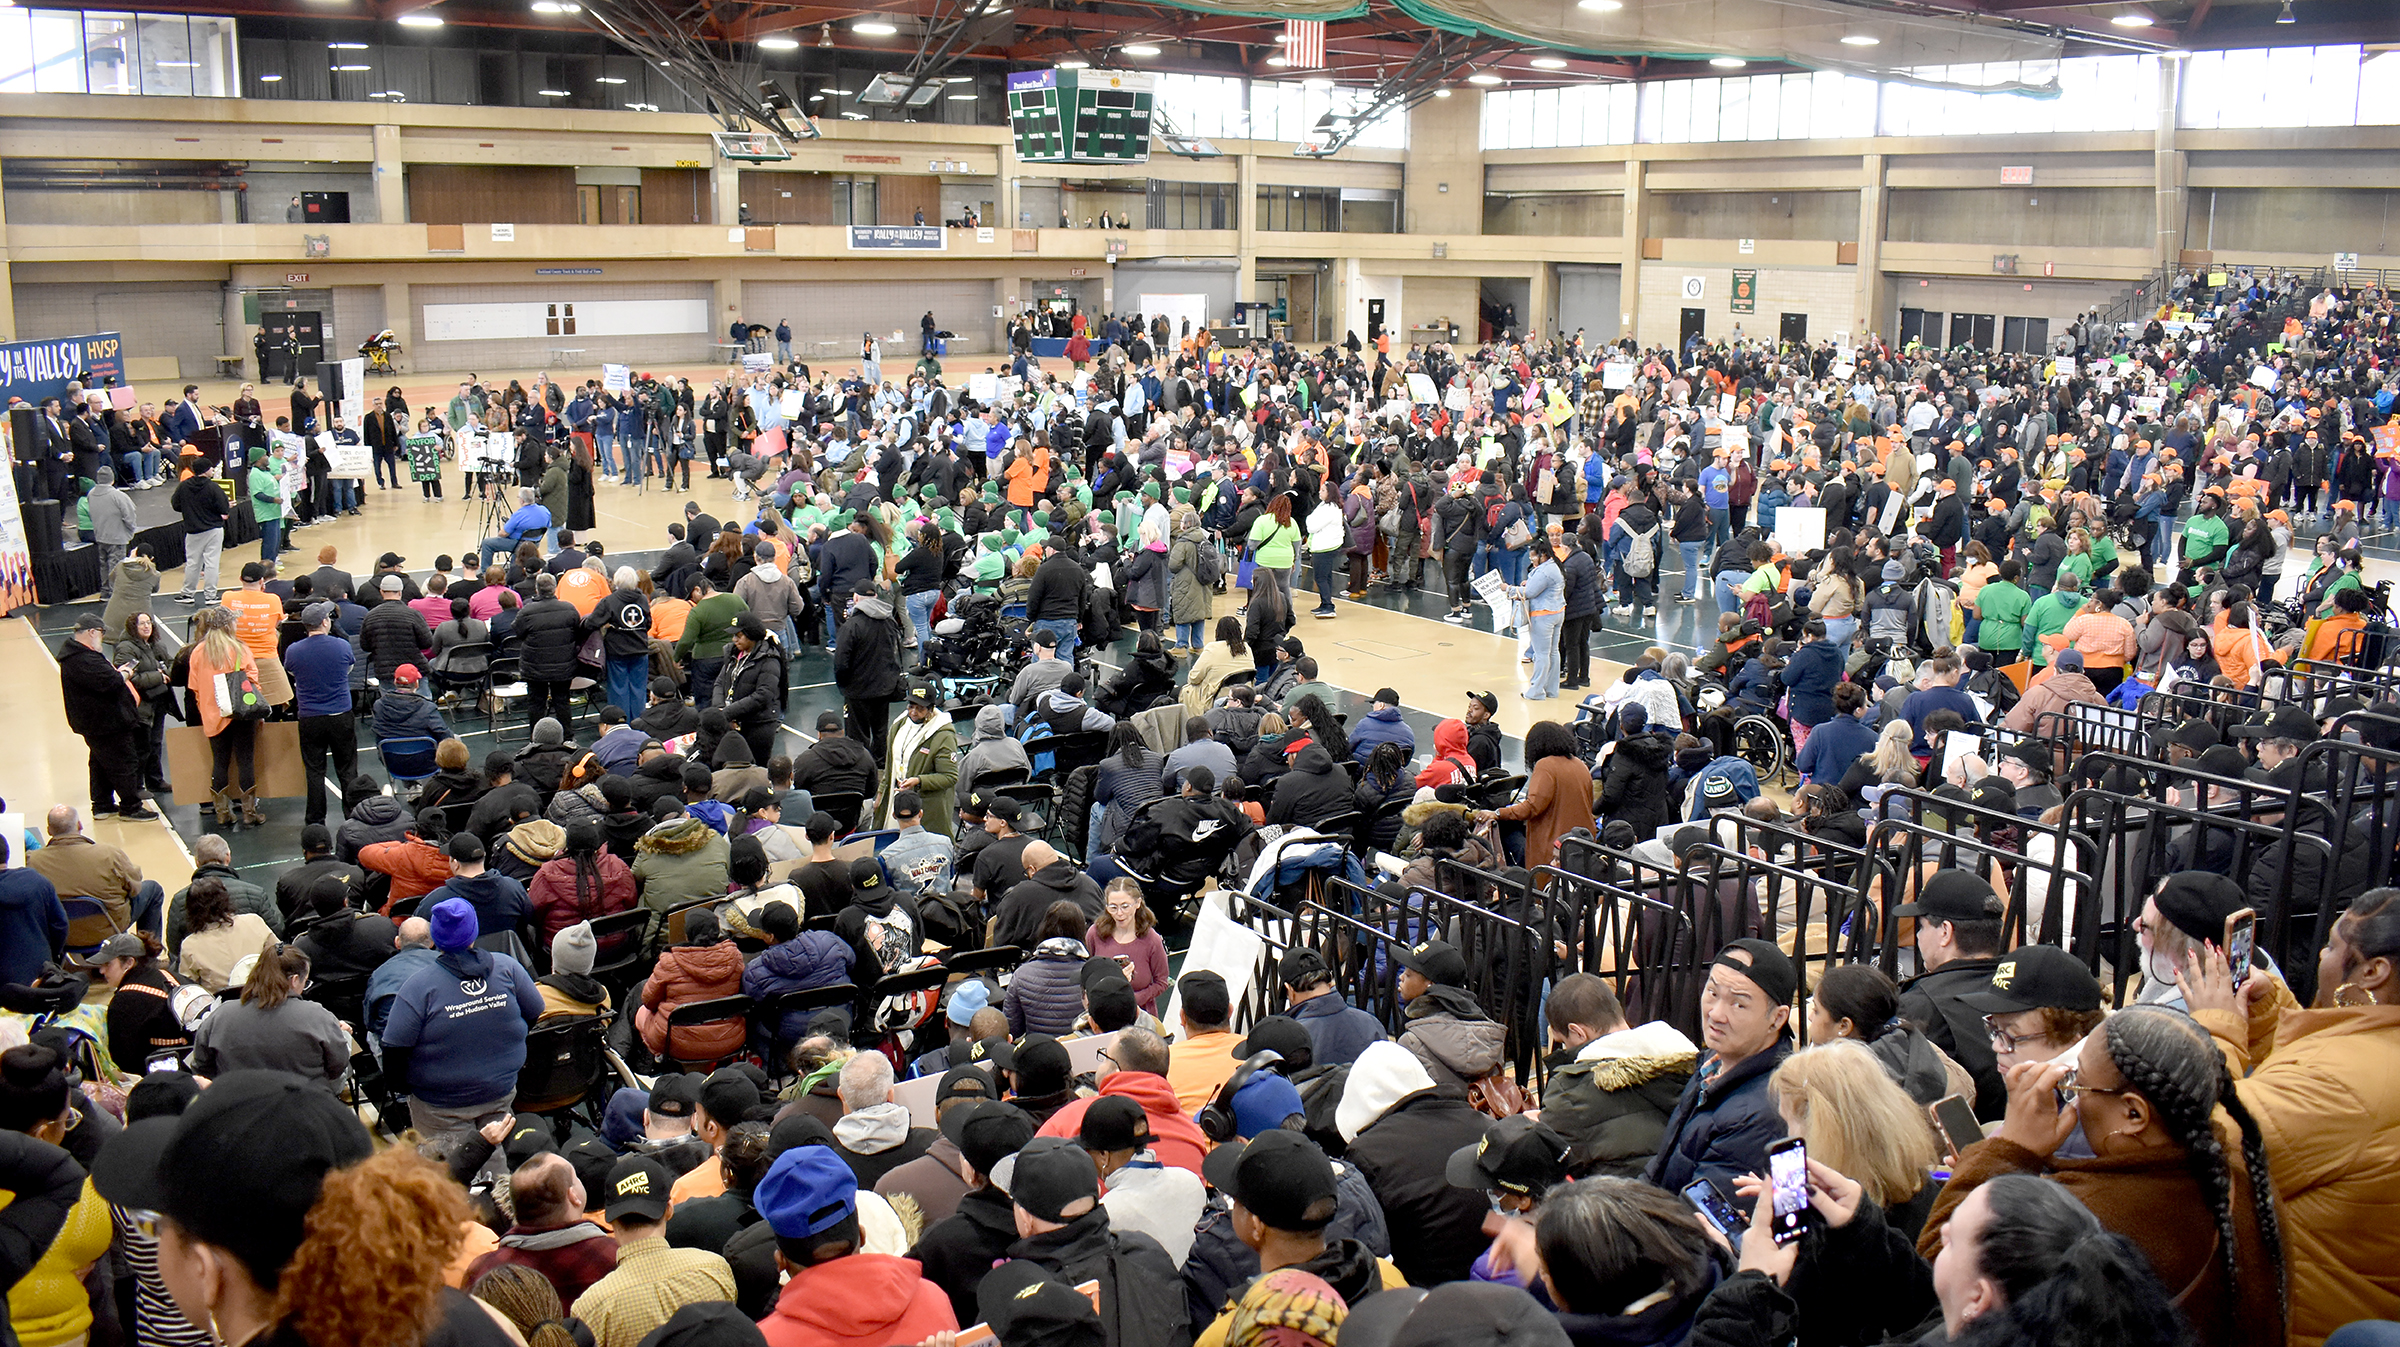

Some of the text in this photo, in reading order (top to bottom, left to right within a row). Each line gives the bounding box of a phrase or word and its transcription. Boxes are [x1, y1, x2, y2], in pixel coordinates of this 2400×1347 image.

[1080, 107, 1098, 116] HOME
[1130, 110, 1149, 118] GUEST
[675, 160, 701, 168] NORTH
[2002, 167, 2031, 183] EXIT
[874, 229, 894, 240] RALLY
[900, 229, 923, 240] VALLEY
[287, 274, 307, 282] EXIT
[87, 339, 119, 360] HVSP
[14, 351, 22, 365] IN
[24, 342, 82, 383] VALLEY
[13, 365, 27, 380] THE
[431, 447, 440, 473] CARE
[420, 473, 437, 481] DSP
[1197, 819, 1220, 833] NIKE
[1992, 978, 2011, 990] NYC
[444, 993, 508, 1012] Wraparound Services
[456, 1010, 464, 1018] the
[464, 1004, 489, 1015] Hudson
[488, 1000, 507, 1009] Valley
[620, 1174, 646, 1192] AHRC
[632, 1186, 650, 1194] NYC
